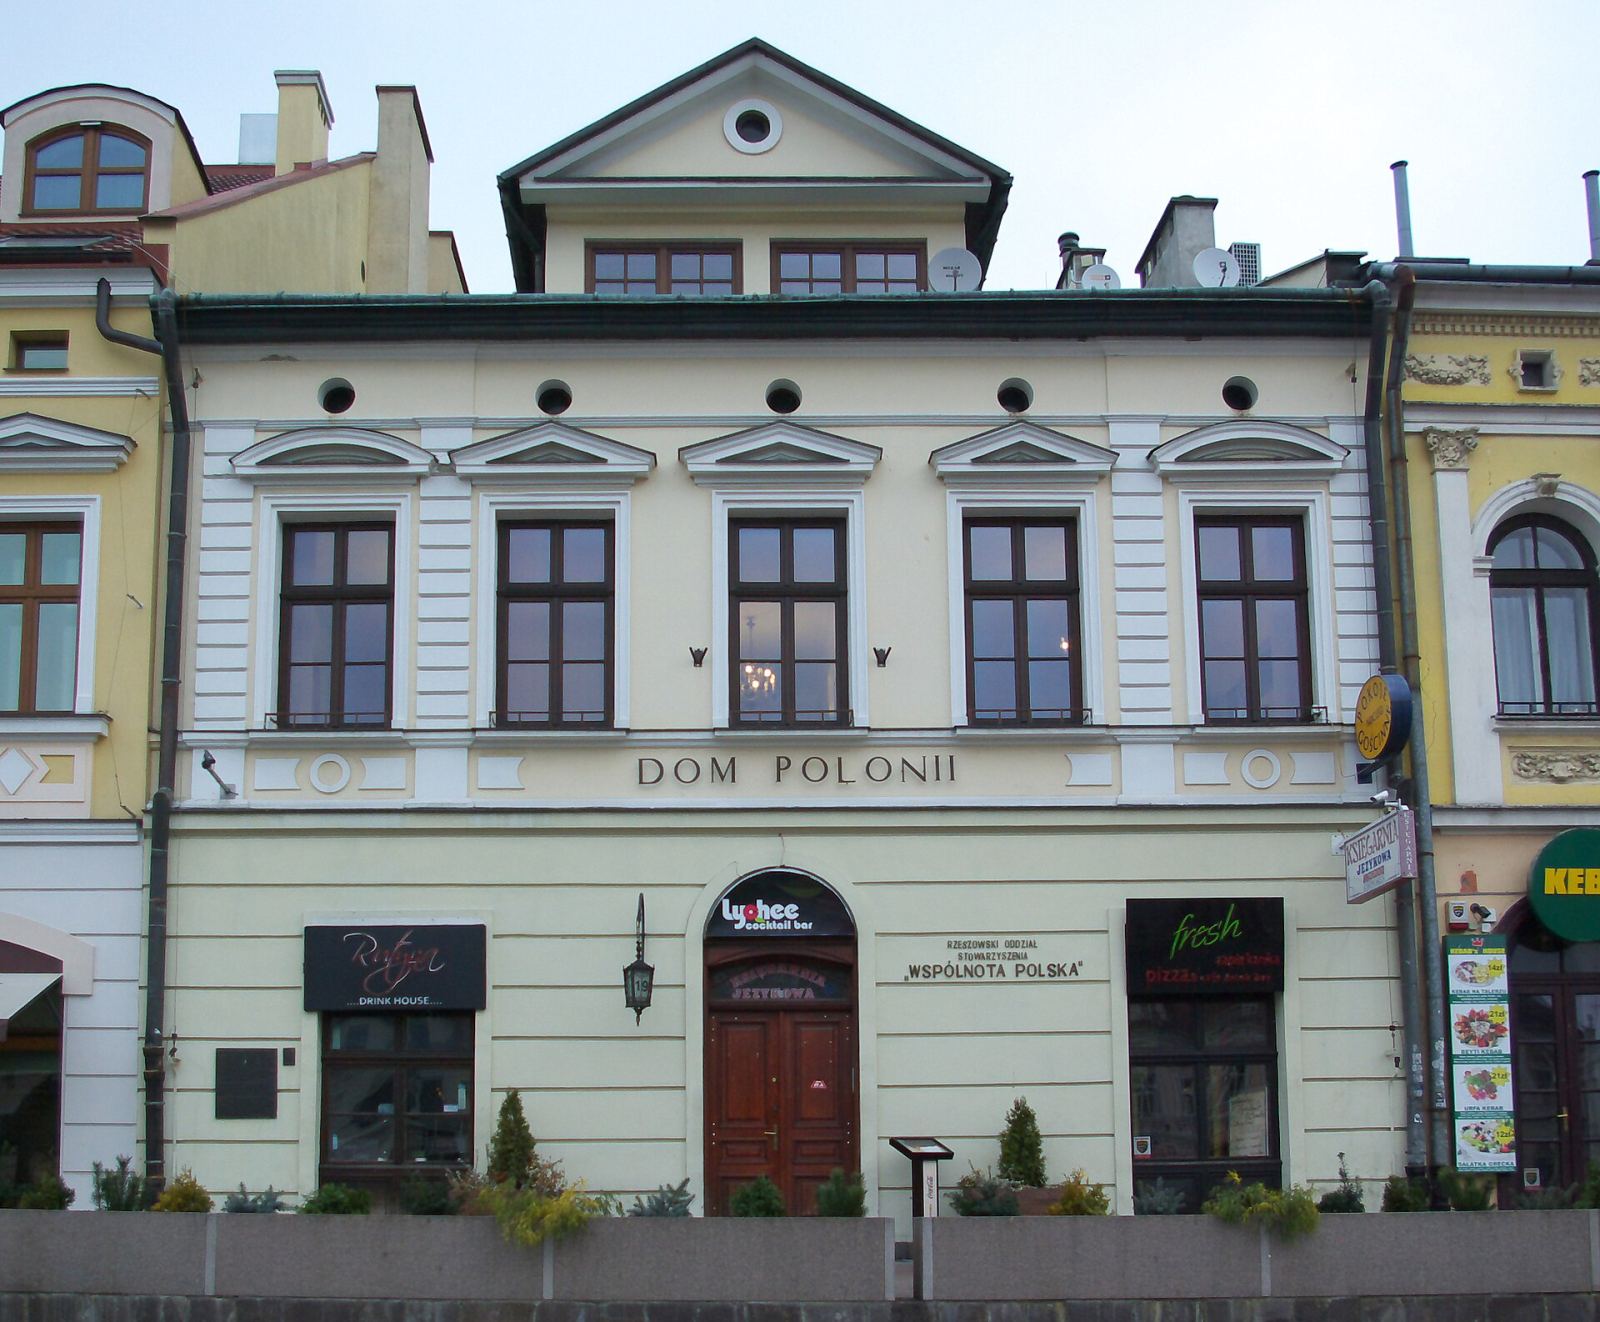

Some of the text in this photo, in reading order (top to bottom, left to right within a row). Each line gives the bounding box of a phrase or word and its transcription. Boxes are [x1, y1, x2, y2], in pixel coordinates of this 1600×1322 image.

[637, 755, 956, 785] DOM POLONII
[745, 920, 813, 930] cocktail bar
[1170, 903, 1242, 960] fresh
[947, 940, 999, 949] RZESZOWSKI
[958, 951, 1028, 961] STOWARZYSZENIA
[359, 996, 430, 1006] DRINK HOUSE
